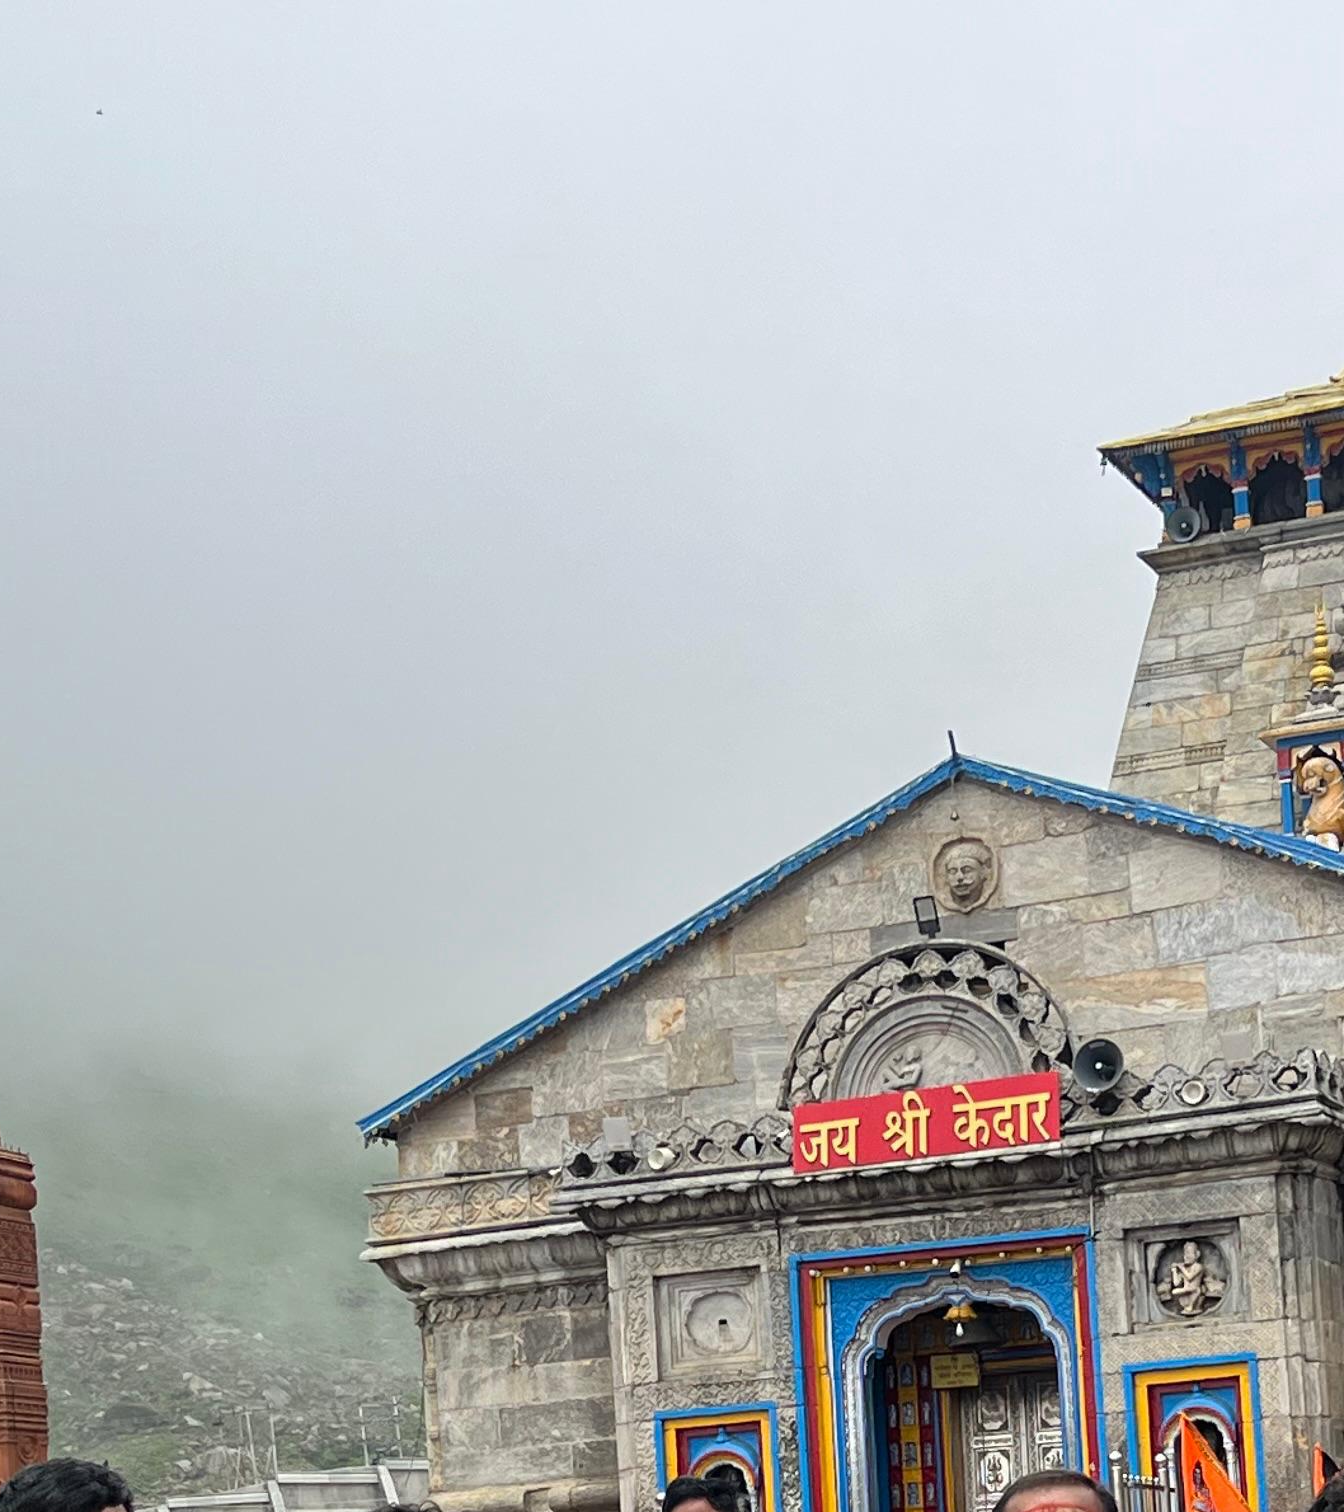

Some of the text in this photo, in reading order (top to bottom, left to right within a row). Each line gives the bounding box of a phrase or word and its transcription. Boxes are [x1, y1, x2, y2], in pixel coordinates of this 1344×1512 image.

[799, 1085, 1051, 1168] जय श्री केदार
